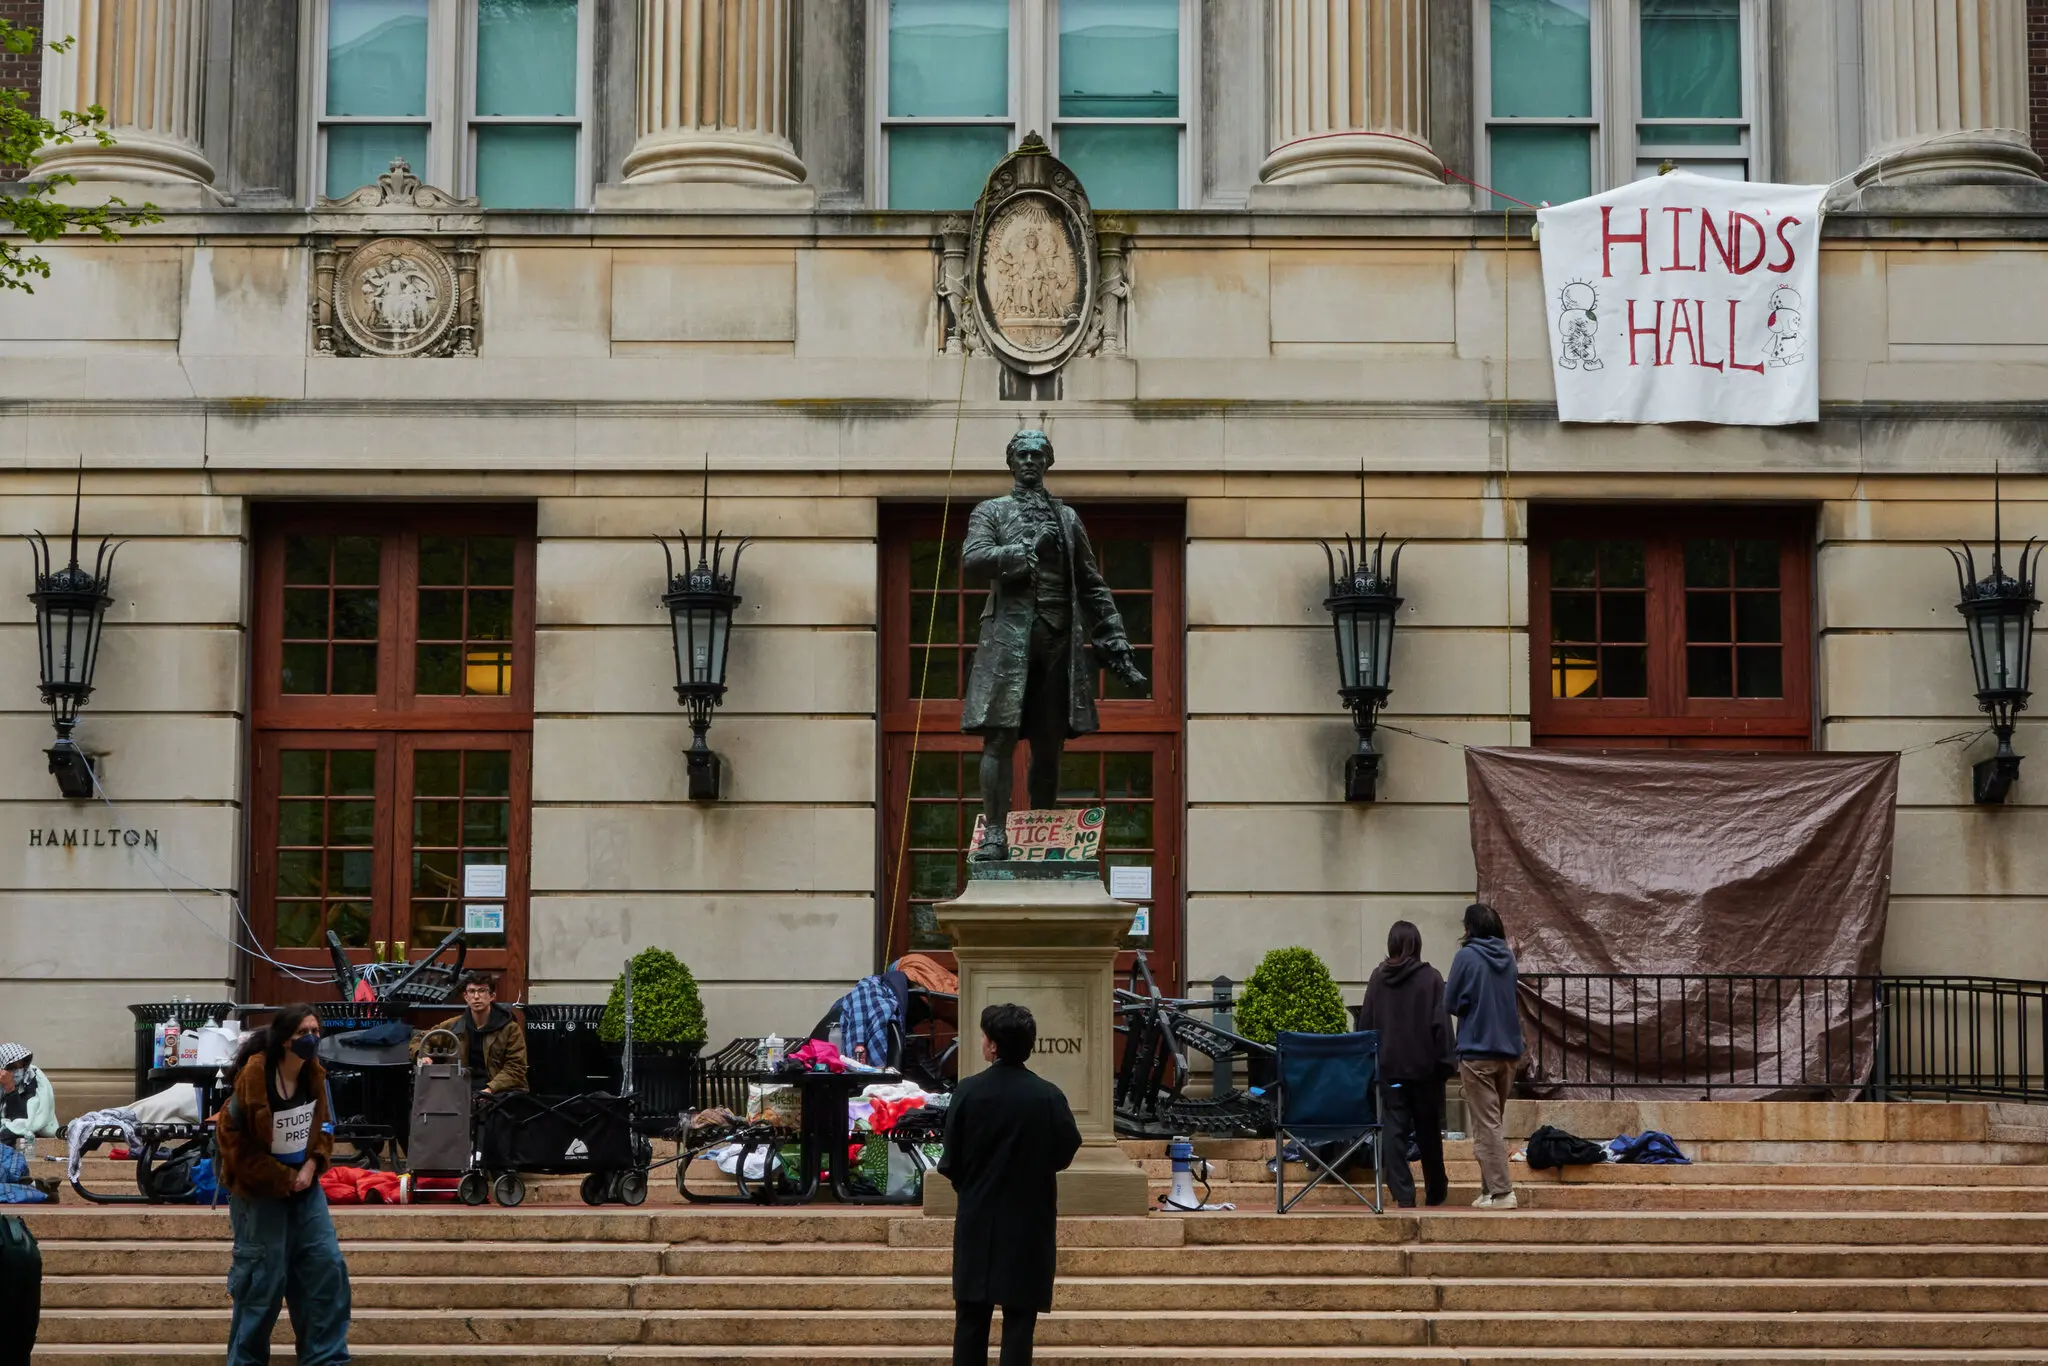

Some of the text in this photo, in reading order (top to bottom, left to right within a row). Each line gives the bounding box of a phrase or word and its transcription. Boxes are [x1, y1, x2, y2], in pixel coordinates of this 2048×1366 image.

[1600, 206, 1802, 278] HIND'S
[1627, 299, 1765, 375] HALL
[29, 828, 158, 847] HAMILTON
[972, 824, 1062, 845] JTICE
[1074, 831, 1098, 846] NO
[182, 1020, 204, 1029] MIXE
[527, 1022, 556, 1031] TRASH
[1031, 1037, 1082, 1054] ILTON
[276, 1111, 313, 1129] STUDE
[285, 1127, 310, 1142] PRES
